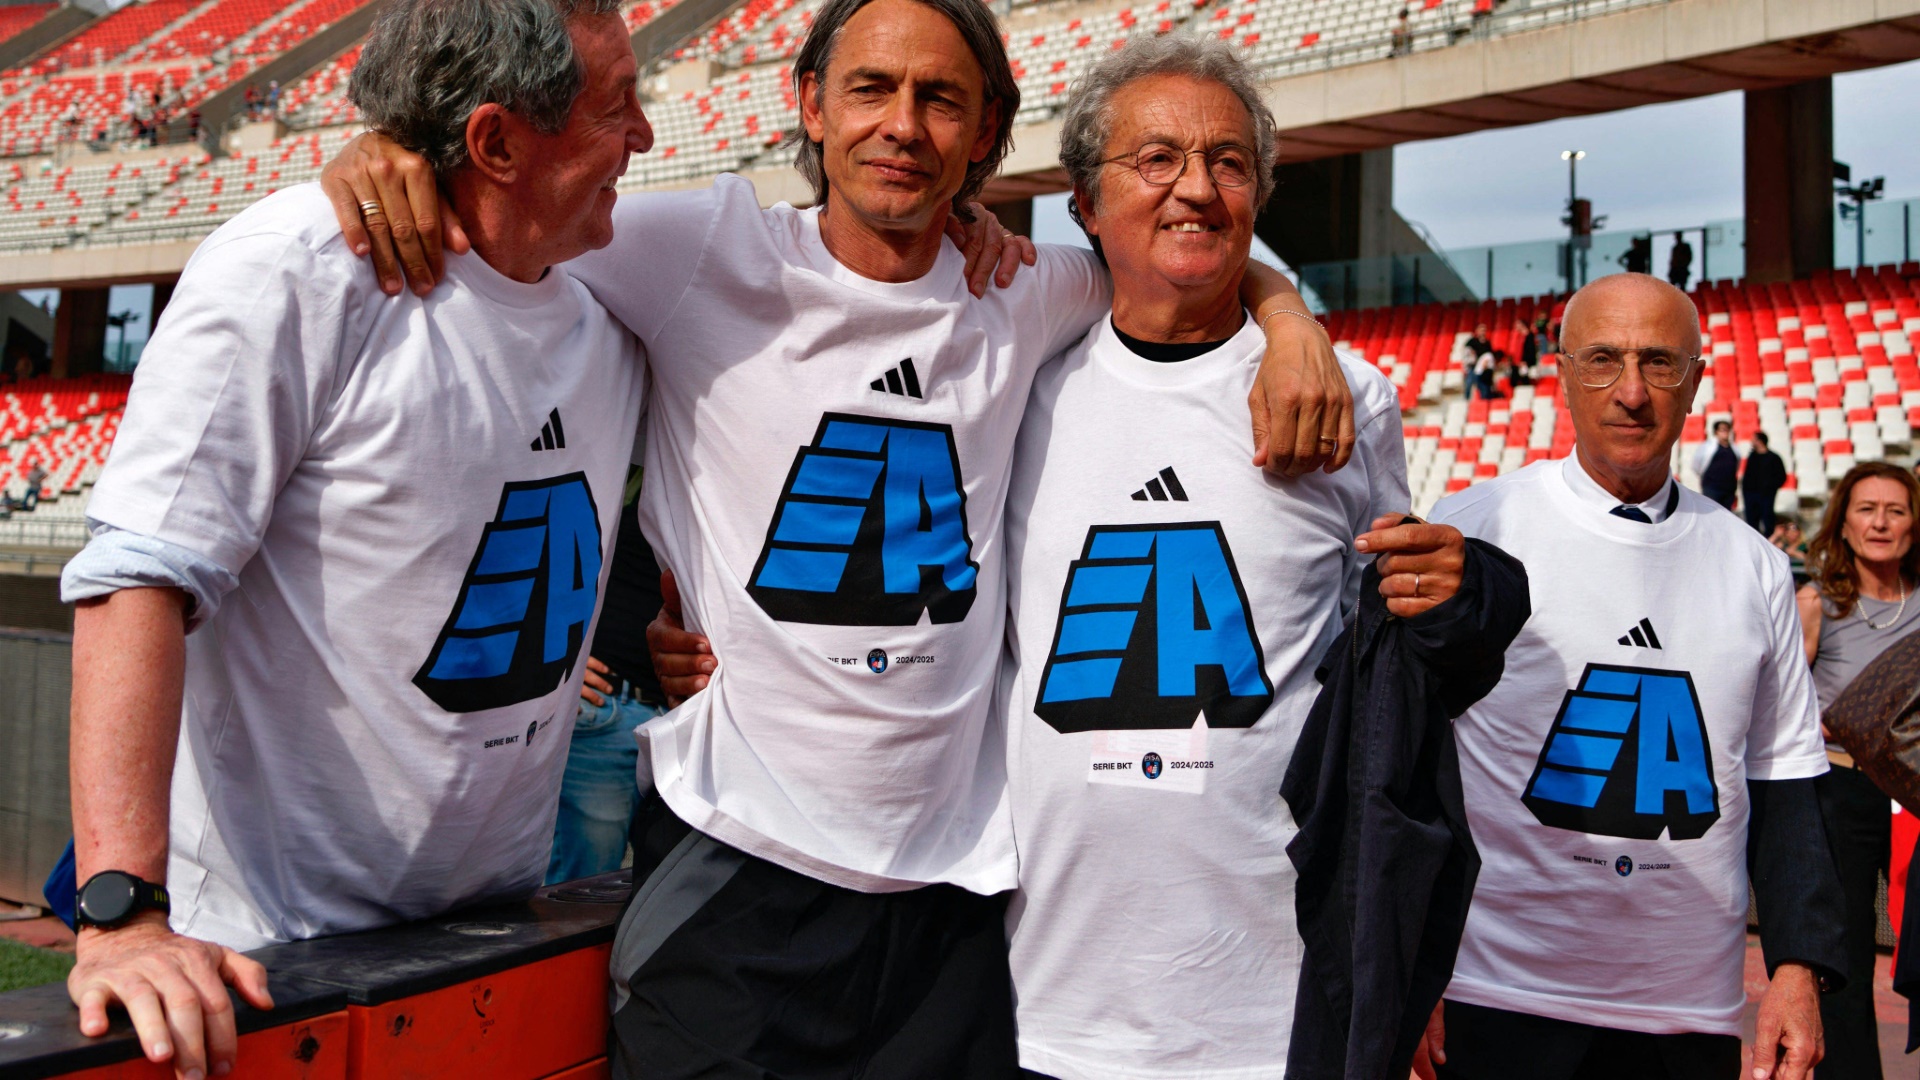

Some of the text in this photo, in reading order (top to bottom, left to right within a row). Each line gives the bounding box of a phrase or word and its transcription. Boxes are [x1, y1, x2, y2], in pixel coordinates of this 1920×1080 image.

[895, 656, 935, 664] 2024/2025
[484, 735, 519, 748] SERIE BKT
[1144, 754, 1161, 762] PISA
[1092, 761, 1214, 771] SERIE BKT 2024/2025
